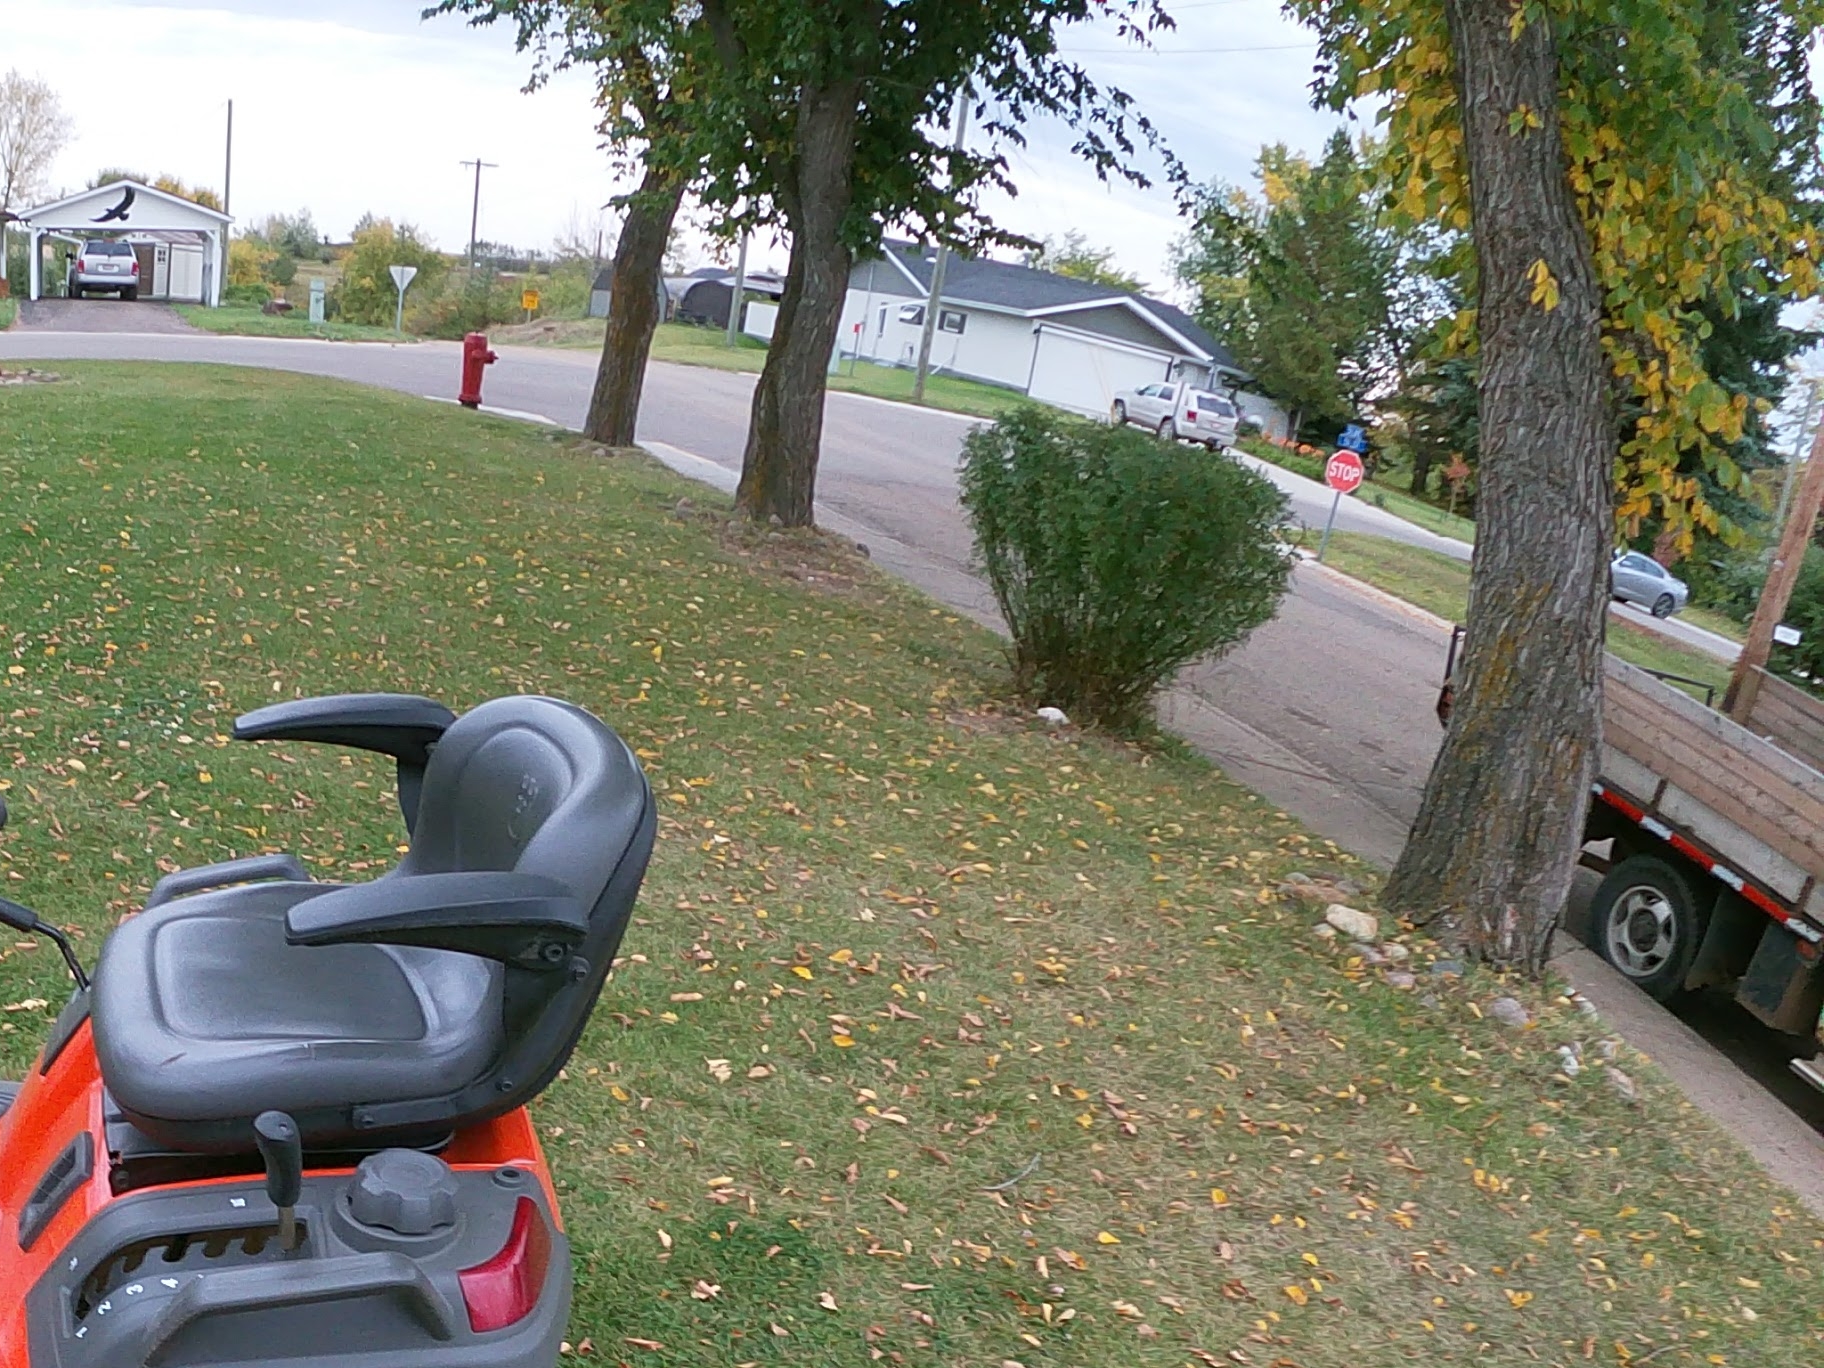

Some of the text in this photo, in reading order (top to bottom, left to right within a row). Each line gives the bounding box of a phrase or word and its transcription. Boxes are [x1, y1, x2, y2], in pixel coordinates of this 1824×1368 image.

[1329, 461, 1360, 482] STOP
[98, 1301, 112, 1315] 2
[126, 1284, 144, 1295] 3
[160, 1278, 178, 1288] 4
